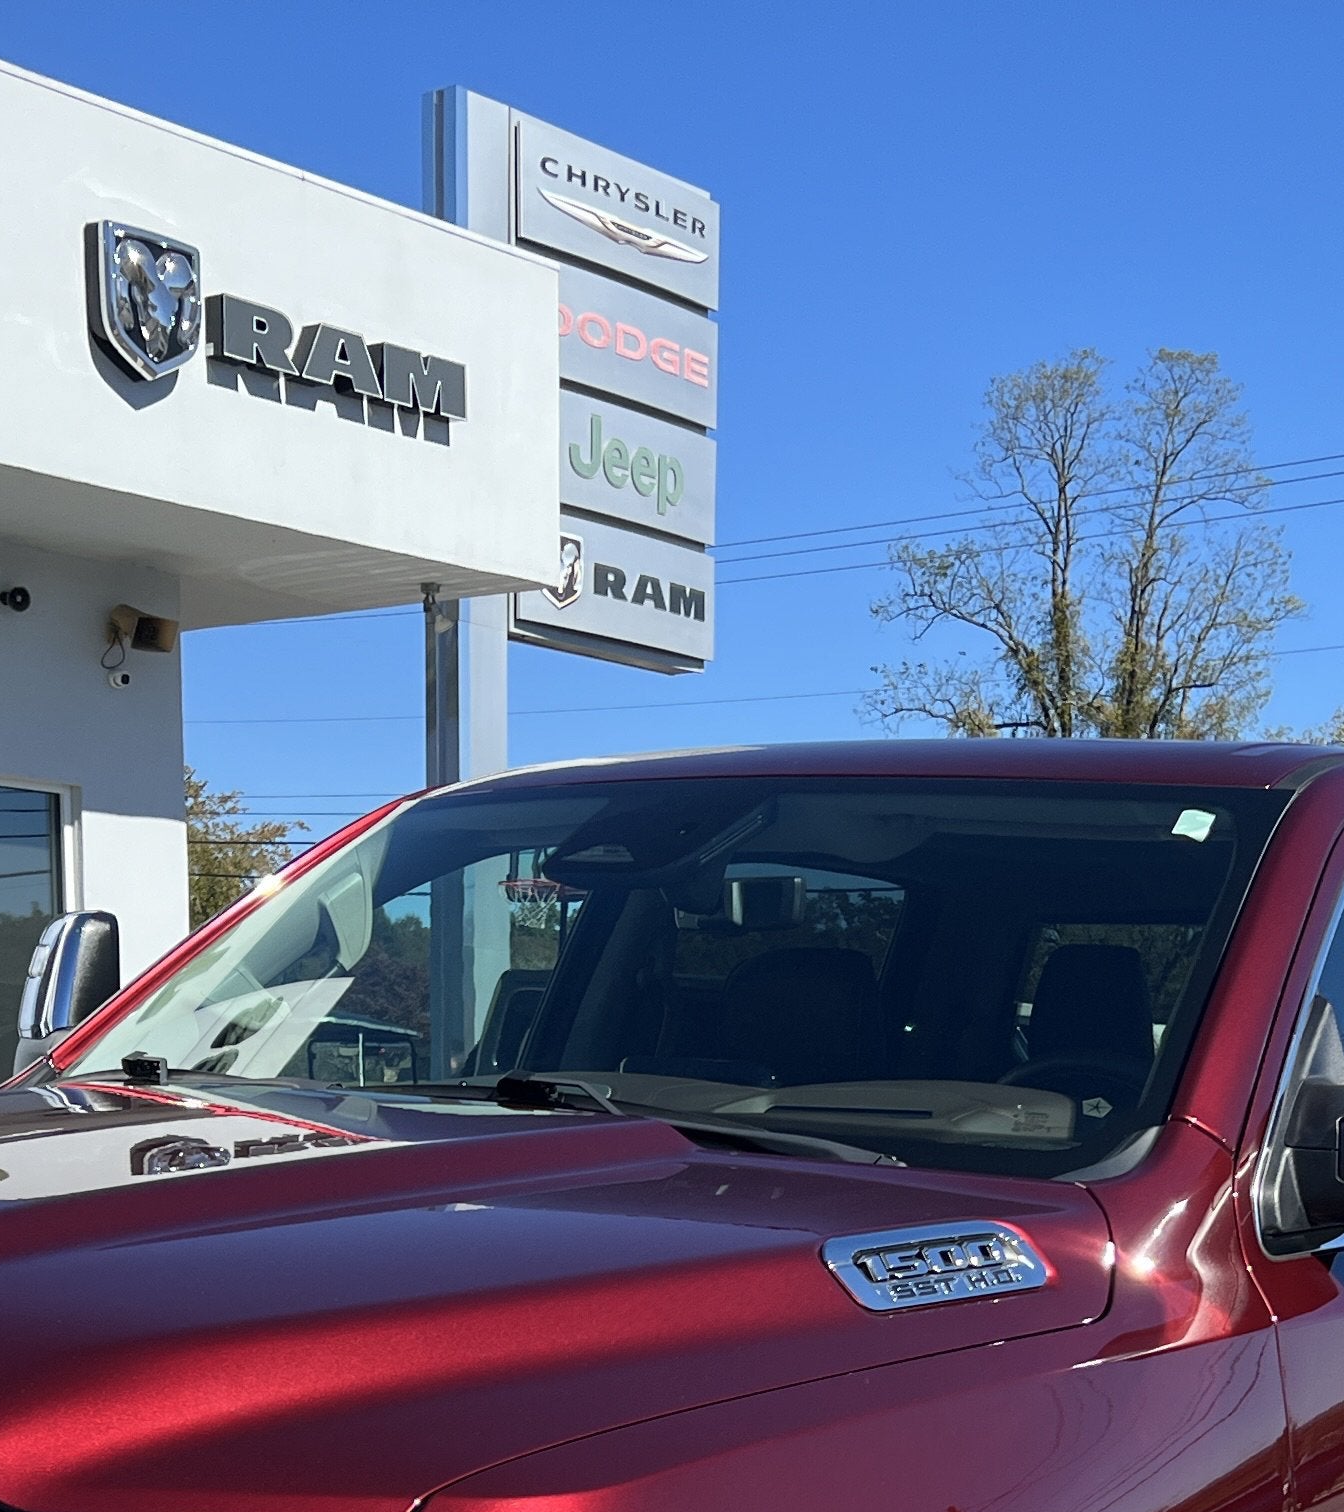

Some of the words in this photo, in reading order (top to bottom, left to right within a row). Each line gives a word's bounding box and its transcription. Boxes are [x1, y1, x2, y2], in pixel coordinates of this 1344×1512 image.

[539, 156, 707, 239] CHRYSLER
[206, 293, 468, 422] RAM
[568, 412, 684, 516] Jeep
[593, 561, 706, 623] RAM
[858, 1238, 1005, 1284] 1500
[889, 1276, 956, 1301] SST
